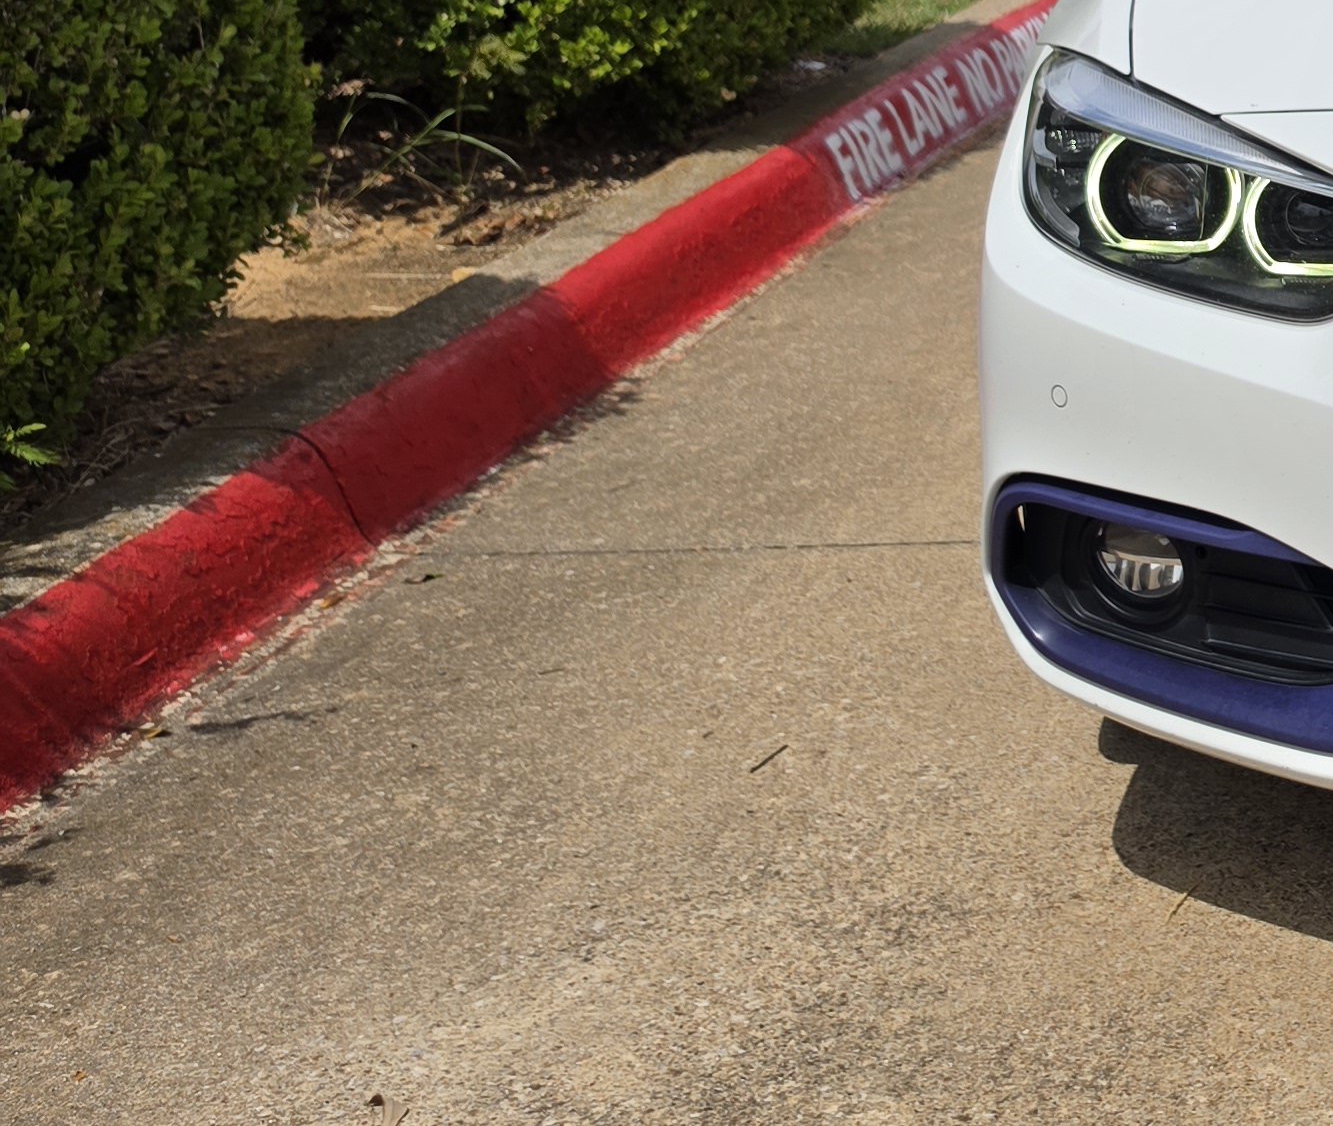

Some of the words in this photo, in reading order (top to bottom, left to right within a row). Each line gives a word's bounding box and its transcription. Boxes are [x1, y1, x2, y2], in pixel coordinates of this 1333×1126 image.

[825, 109, 903, 201] FIRE
[883, 66, 968, 156] LANE
[956, 47, 1005, 116] NO
